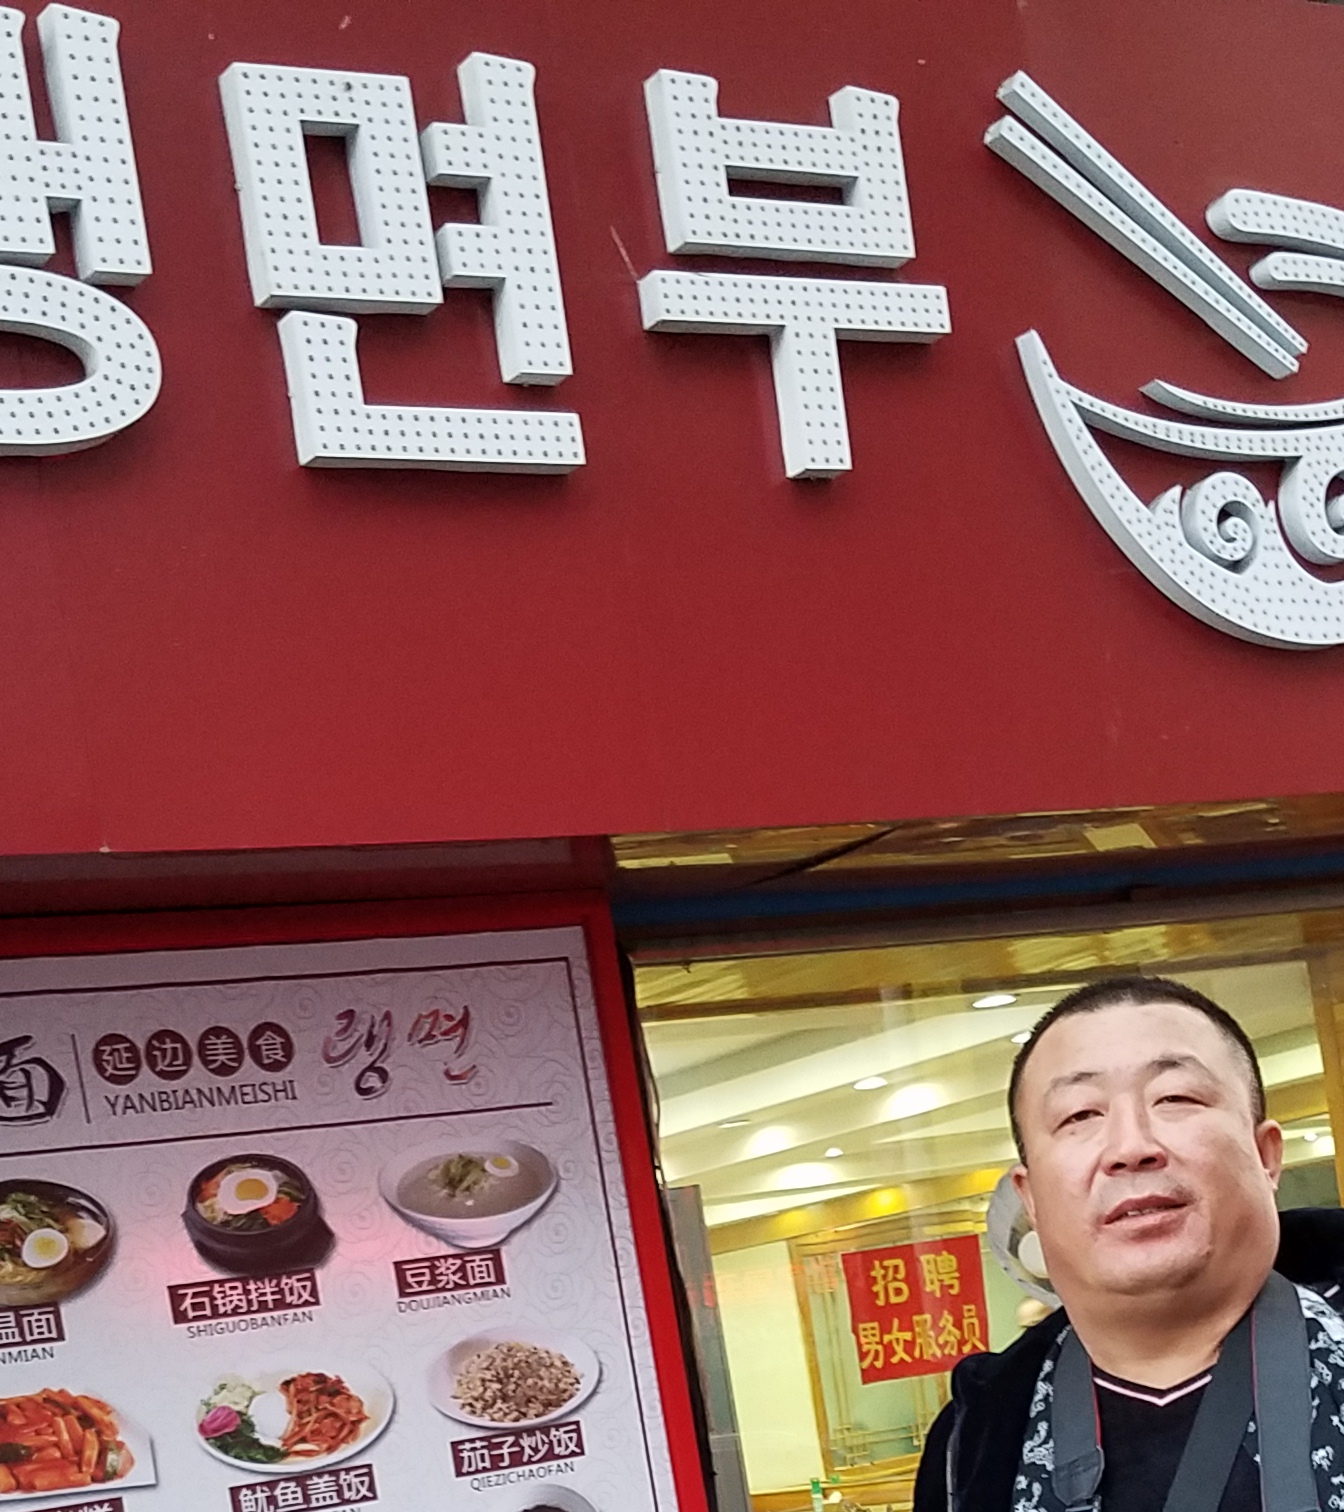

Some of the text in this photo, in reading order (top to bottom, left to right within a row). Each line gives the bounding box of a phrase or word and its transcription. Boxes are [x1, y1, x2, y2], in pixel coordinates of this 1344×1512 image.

[98, 1030, 288, 1078] 延边美食
[104, 1079, 298, 1117] YANBIANMEISHI
[402, 1253, 498, 1294] 豆浆面
[870, 1250, 961, 1307] 招聘
[177, 1274, 317, 1320] 石锅拌饭
[396, 1286, 512, 1314] DOUJIANGMIAN
[186, 1311, 314, 1340] SHIGUOBANFAN
[857, 1304, 987, 1370] 男女服务员
[458, 1426, 580, 1474] 茄子炒饭
[469, 1461, 575, 1492] QIEZICHAOFAN
